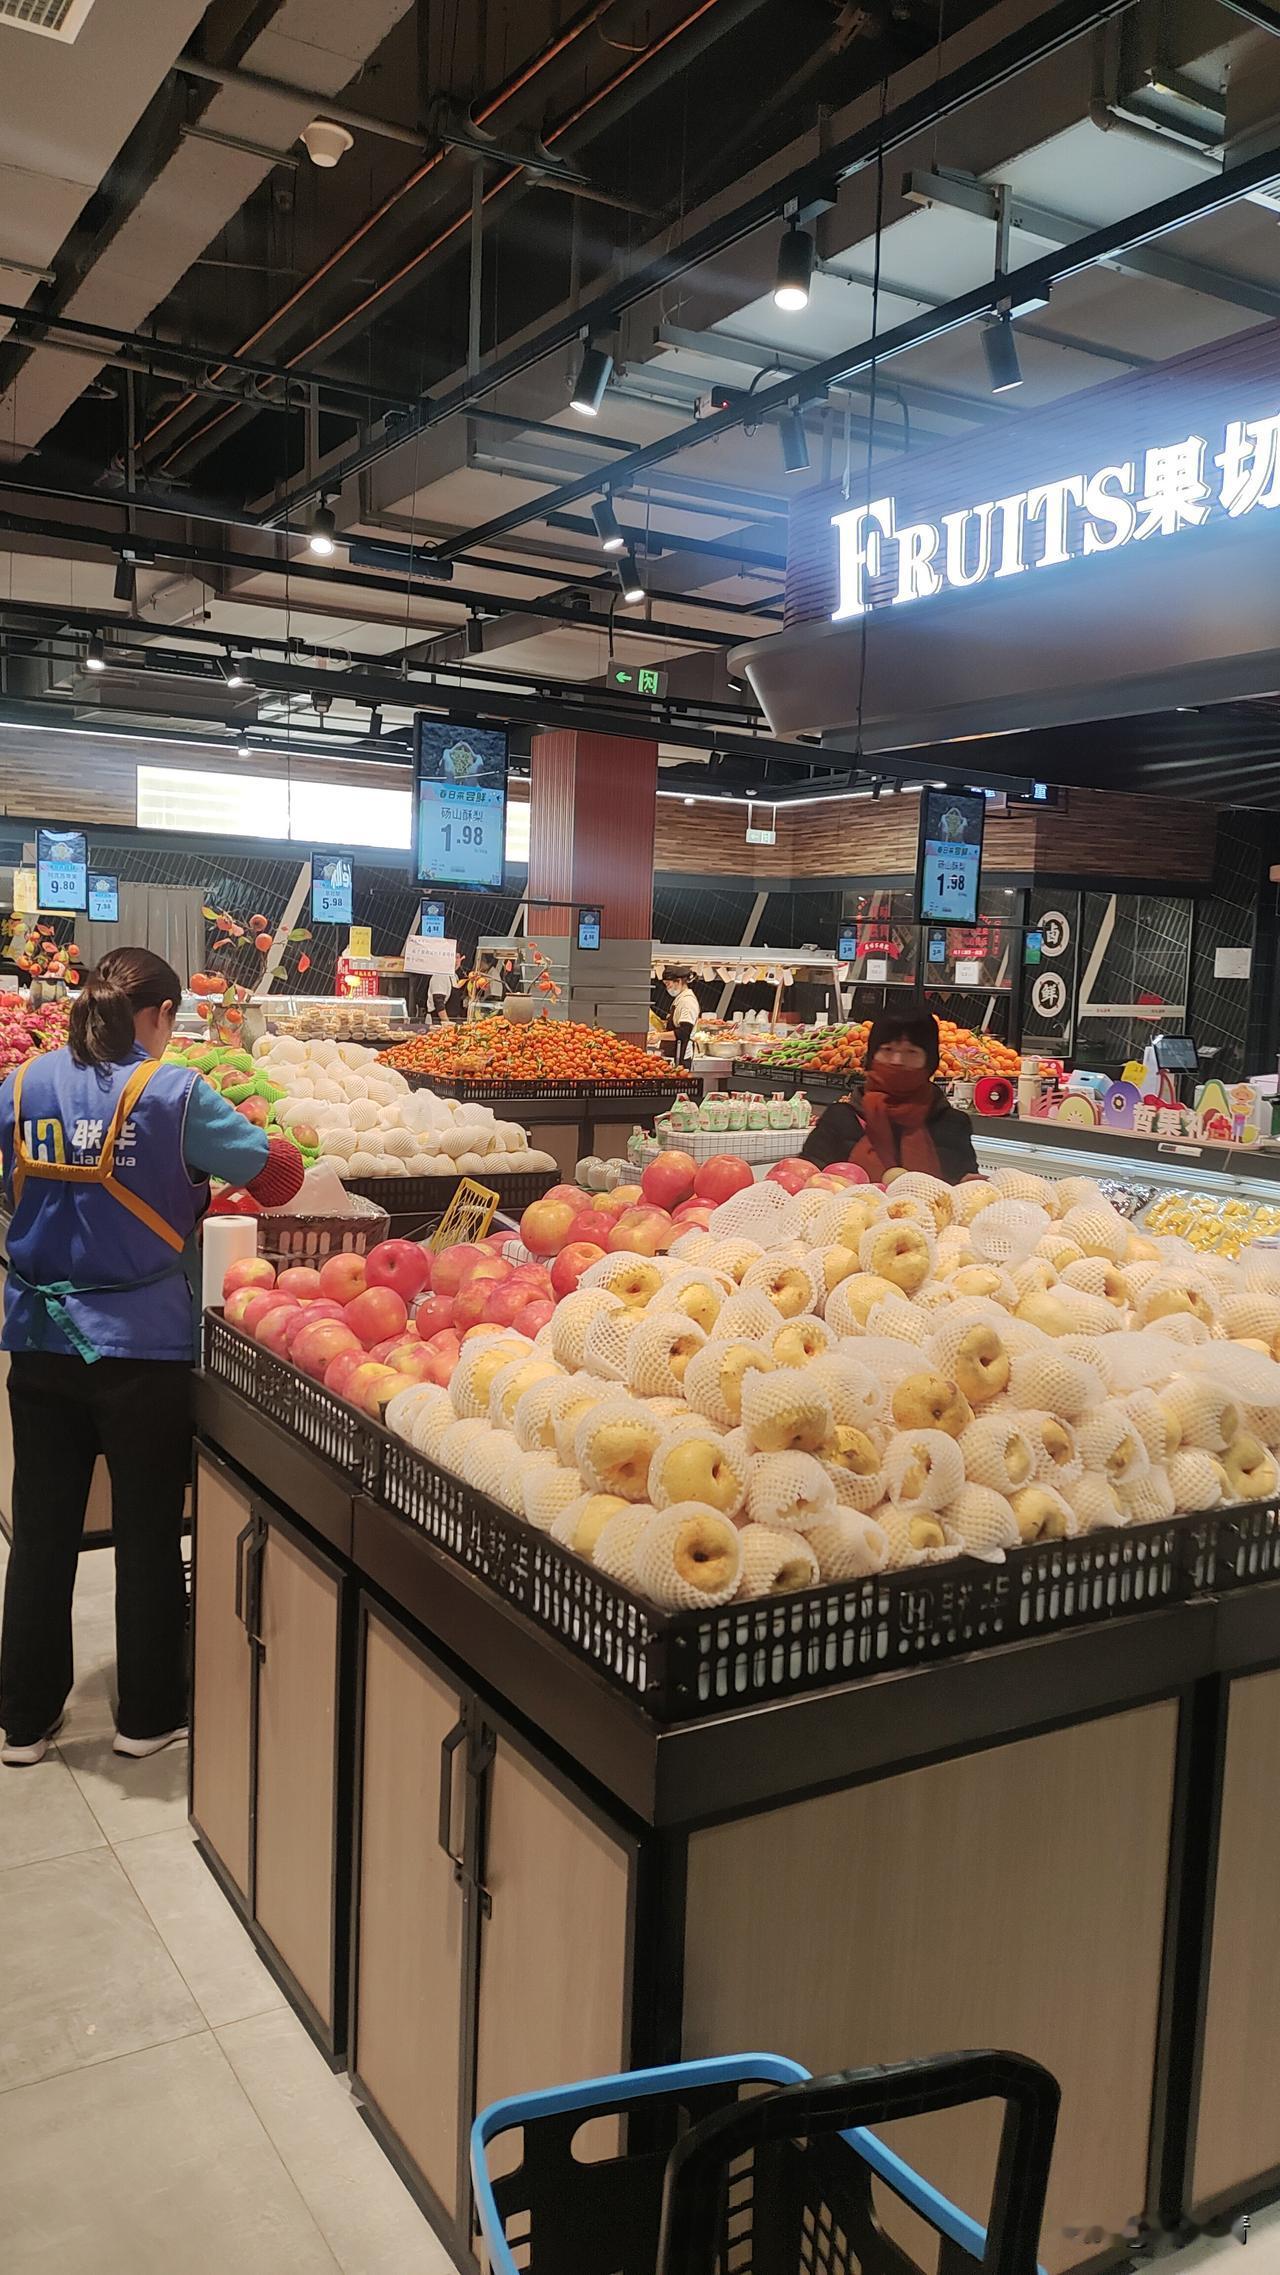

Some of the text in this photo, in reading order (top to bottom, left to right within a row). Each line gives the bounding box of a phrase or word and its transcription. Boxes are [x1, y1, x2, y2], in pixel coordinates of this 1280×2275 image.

[1134, 412, 1280, 541] 果切
[830, 461, 1136, 622] FRUITS
[441, 806, 484, 822] 砀山酥梨
[441, 823, 484, 852] 1.98
[50, 880, 75, 894] 9.80
[937, 873, 965, 896] 1.98
[322, 897, 343, 910] 5.98
[1040, 983, 1058, 1005] 鲜
[72, 1152, 137, 1167] Lianua
